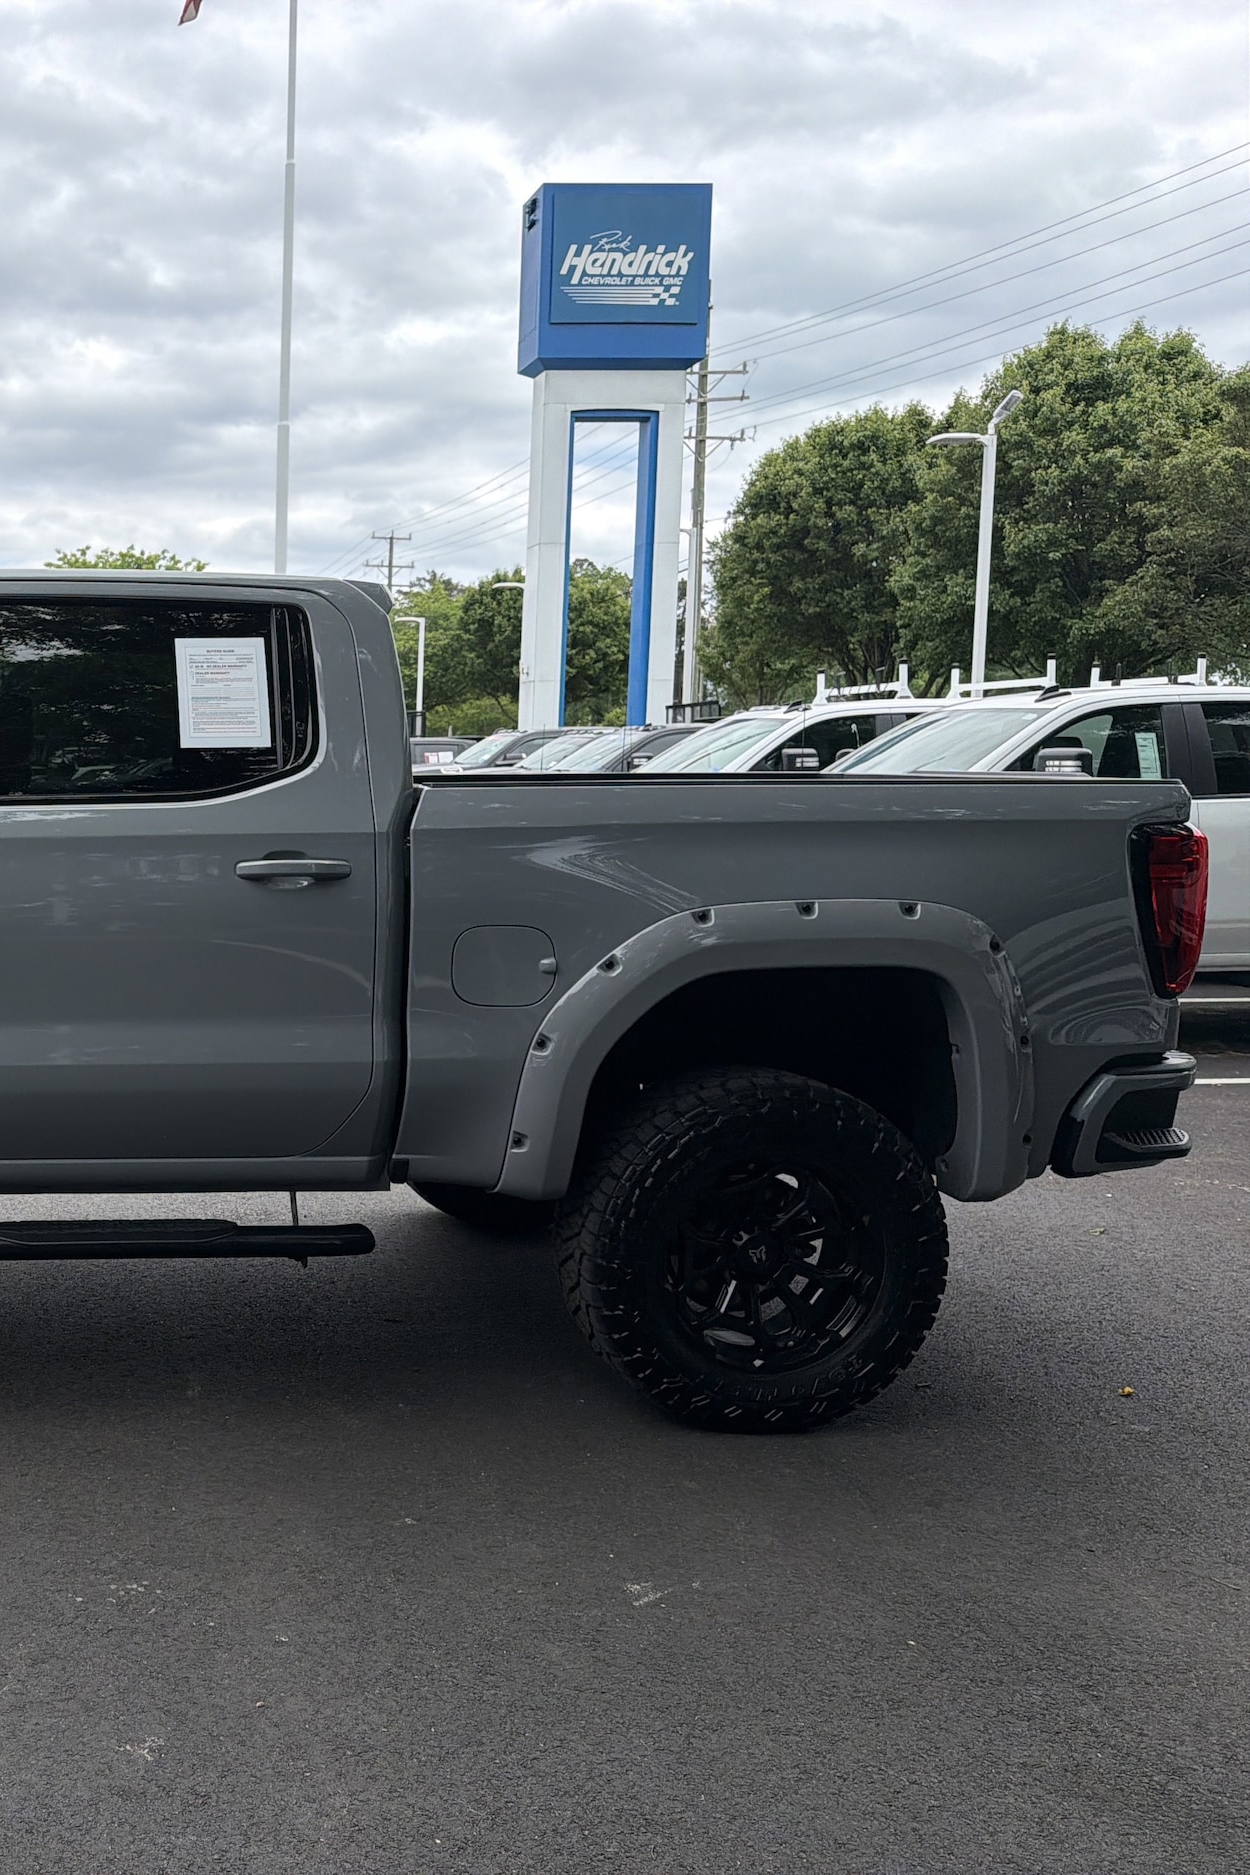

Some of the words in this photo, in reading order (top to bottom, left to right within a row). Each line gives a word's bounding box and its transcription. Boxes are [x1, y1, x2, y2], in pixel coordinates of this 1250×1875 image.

[590, 230, 632, 251] Rick
[559, 244, 694, 284] Hendrick
[581, 276, 632, 285] CHEVROLET
[633, 276, 660, 285] BUICK
[662, 276, 683, 285] GMC
